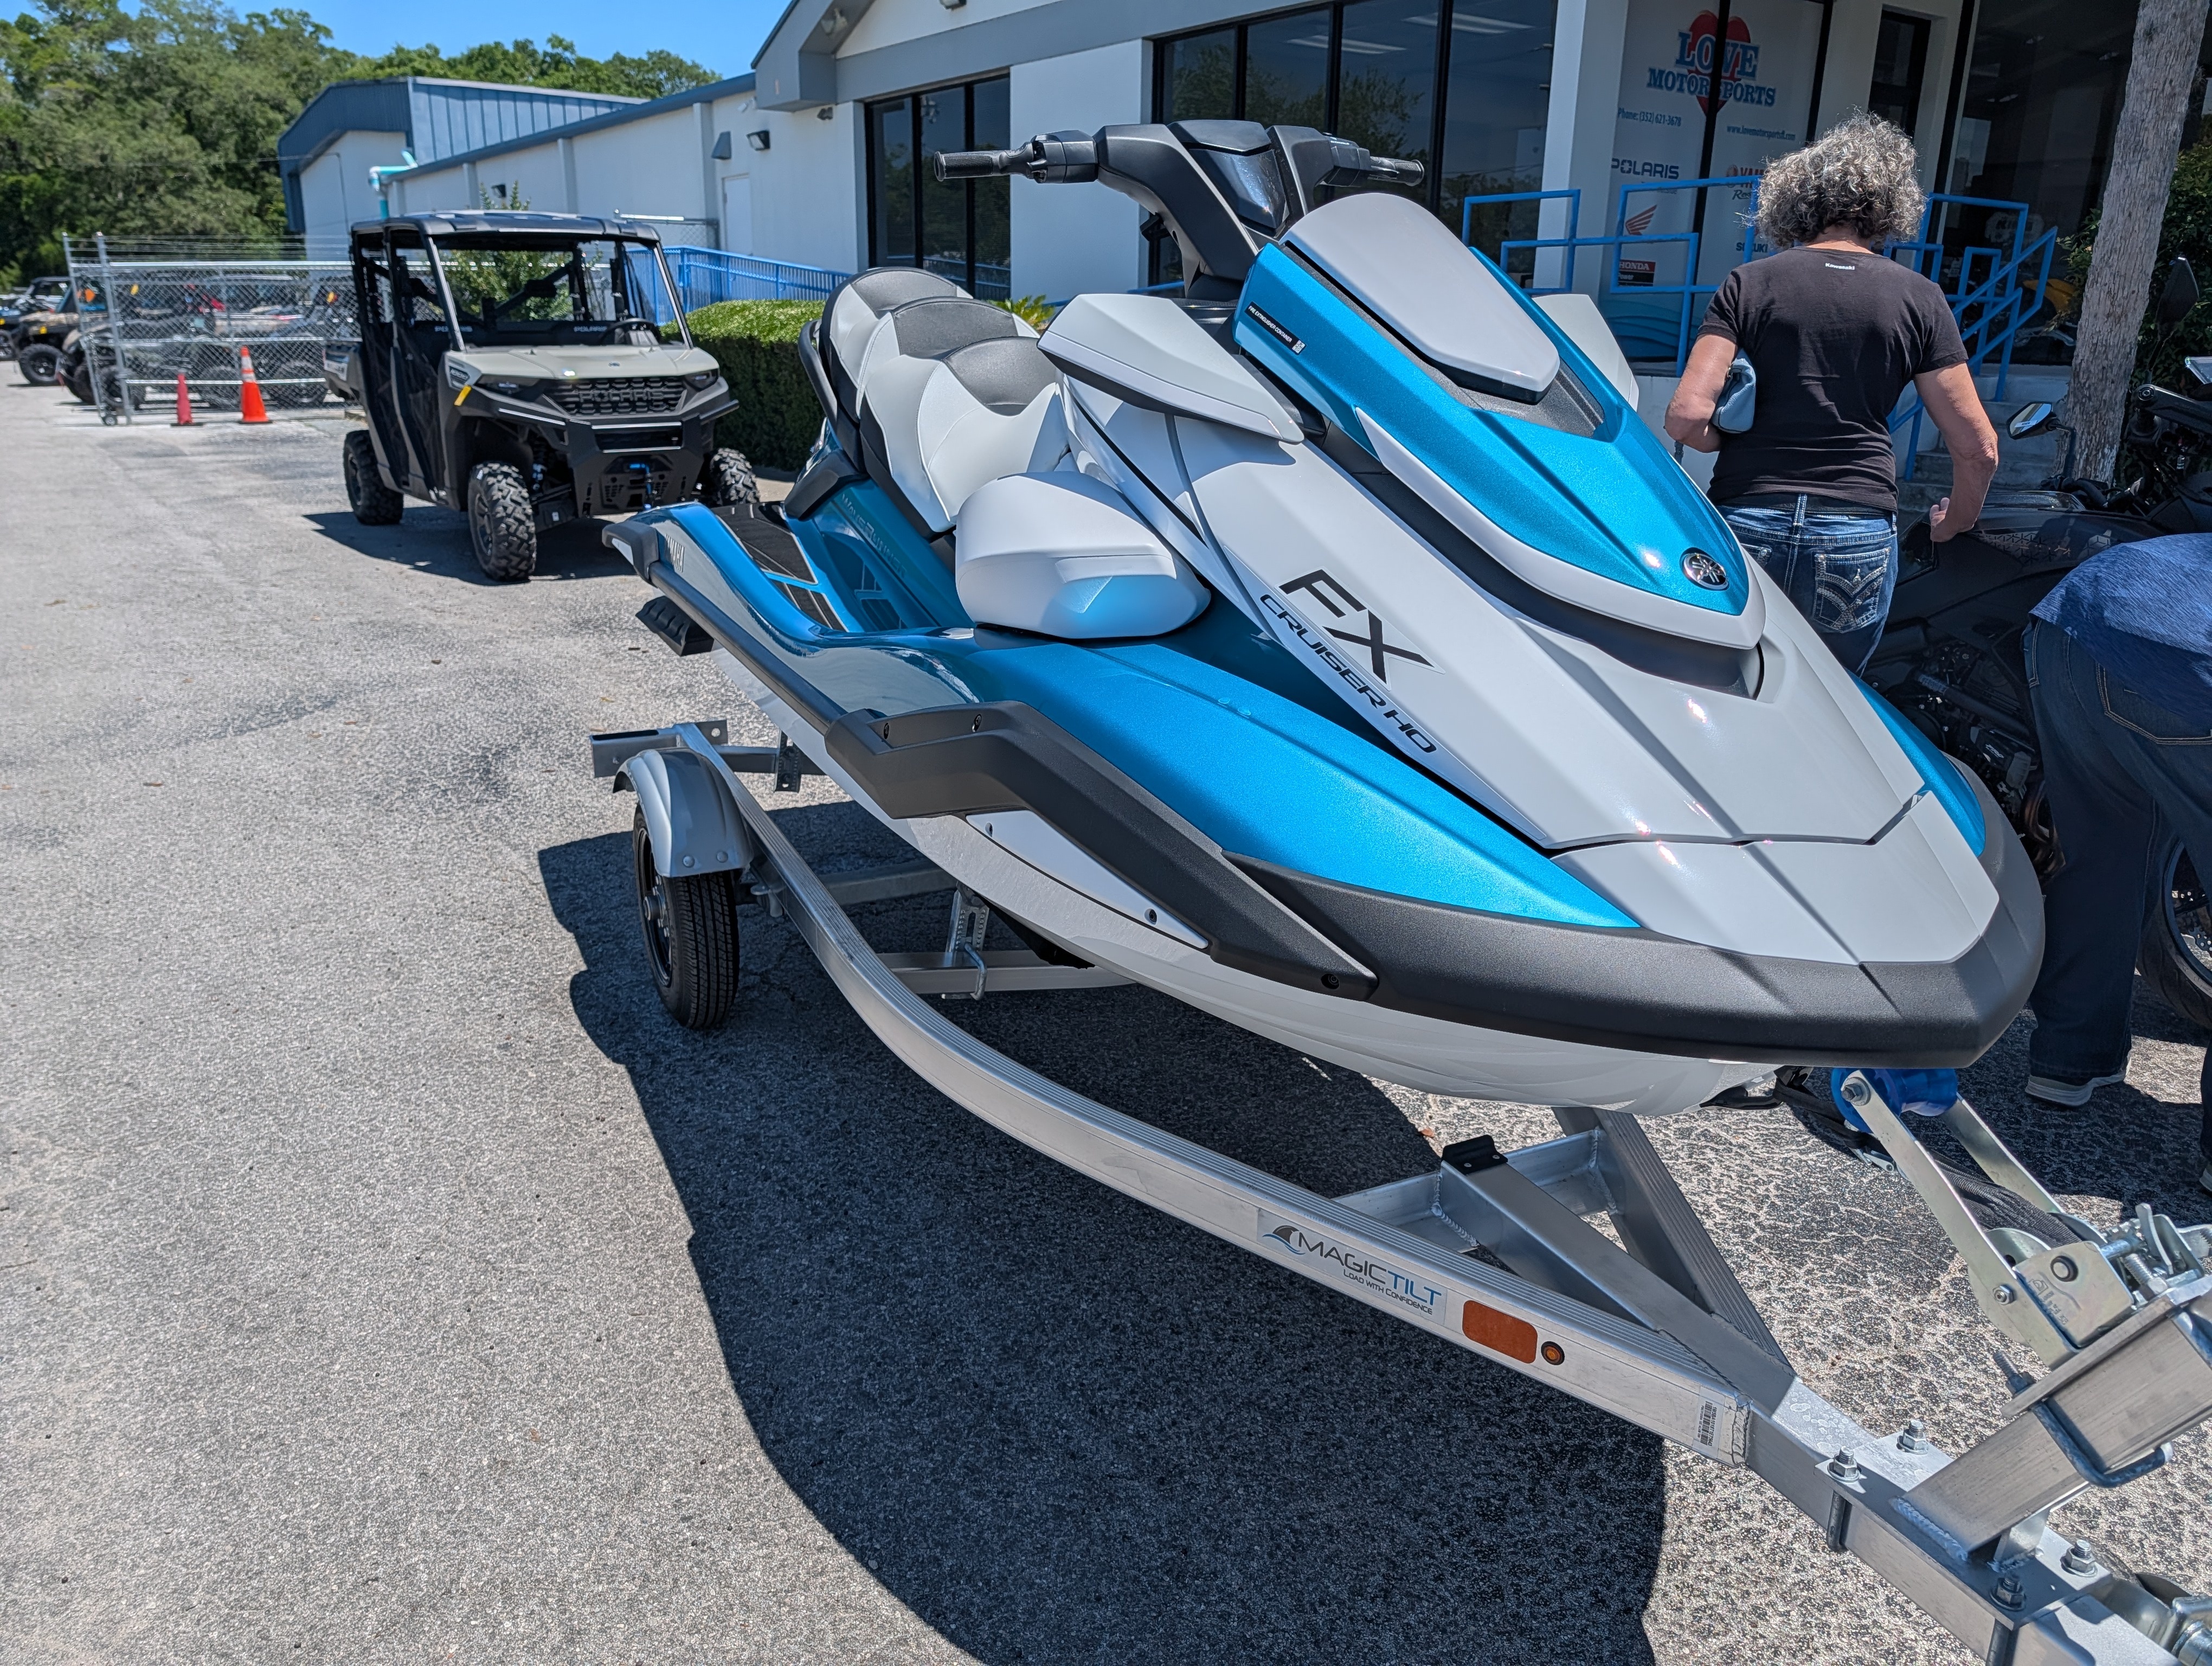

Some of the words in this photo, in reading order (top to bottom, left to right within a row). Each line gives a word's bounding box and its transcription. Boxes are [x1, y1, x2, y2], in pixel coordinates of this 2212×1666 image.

[1675, 31, 1759, 78] LOVE
[1648, 68, 1776, 106] MOTORPORTS
[1639, 112, 1654, 124] (352)
[1655, 113, 1682, 127] 621-3678
[1611, 158, 1679, 180] POLARIS
[1735, 241, 1768, 253] SUKI
[1619, 261, 1650, 271] HONDA
[1825, 262, 1855, 271] Kawasaki
[1248, 305, 1257, 314] FIRE
[1255, 311, 1276, 330] EXTINGUISHER
[1274, 327, 1293, 343] CONTAINER
[1278, 568, 1436, 685] FX
[1259, 594, 1387, 709] CRUISER
[1384, 709, 1437, 754] HO
